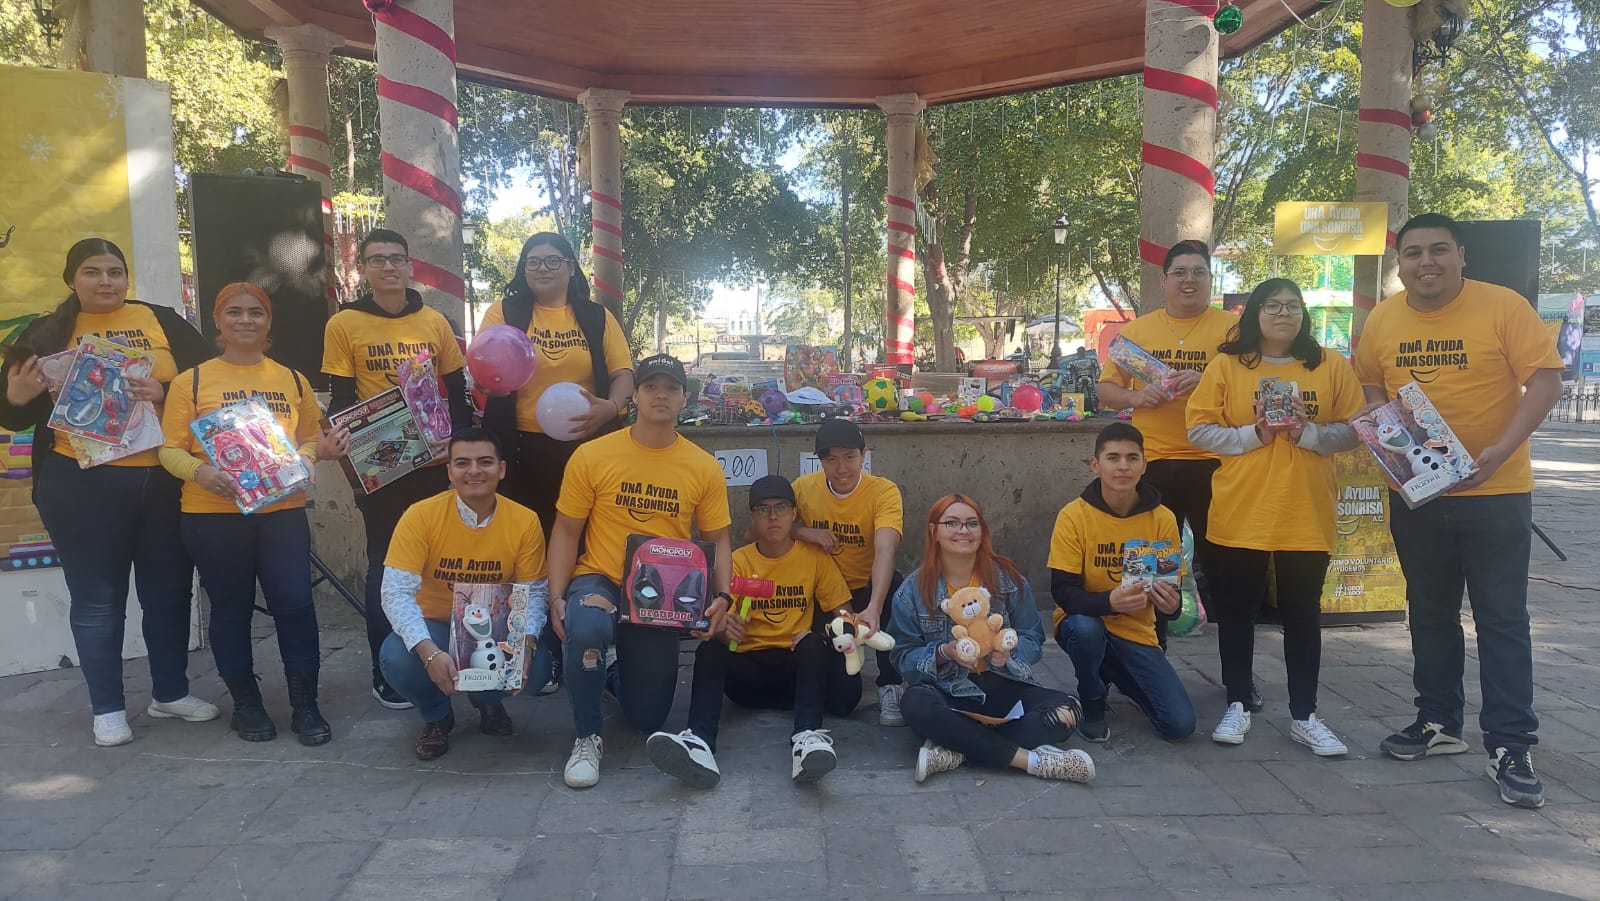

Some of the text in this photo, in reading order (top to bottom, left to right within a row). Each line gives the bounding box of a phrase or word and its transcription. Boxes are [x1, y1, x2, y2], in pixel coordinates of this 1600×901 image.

[1304, 205, 1360, 219] UNA AYUDA
[368, 343, 394, 357] UNA
[1399, 339, 1464, 353] UNA AYUDA
[1175, 350, 1206, 360] AYUDA
[223, 390, 247, 400] UNA
[620, 482, 678, 500] UNA AYUDA
[1345, 485, 1380, 500] AYUDA
[1337, 501, 1384, 516] SONRISA
[832, 521, 860, 534] AYUDA
[650, 545, 692, 557] MONOPOLY
[1097, 542, 1116, 555] UNA
[440, 557, 501, 571] UNA AYUDA
[775, 585, 804, 597] AYUDA
[640, 608, 694, 622] DEADPOOL
